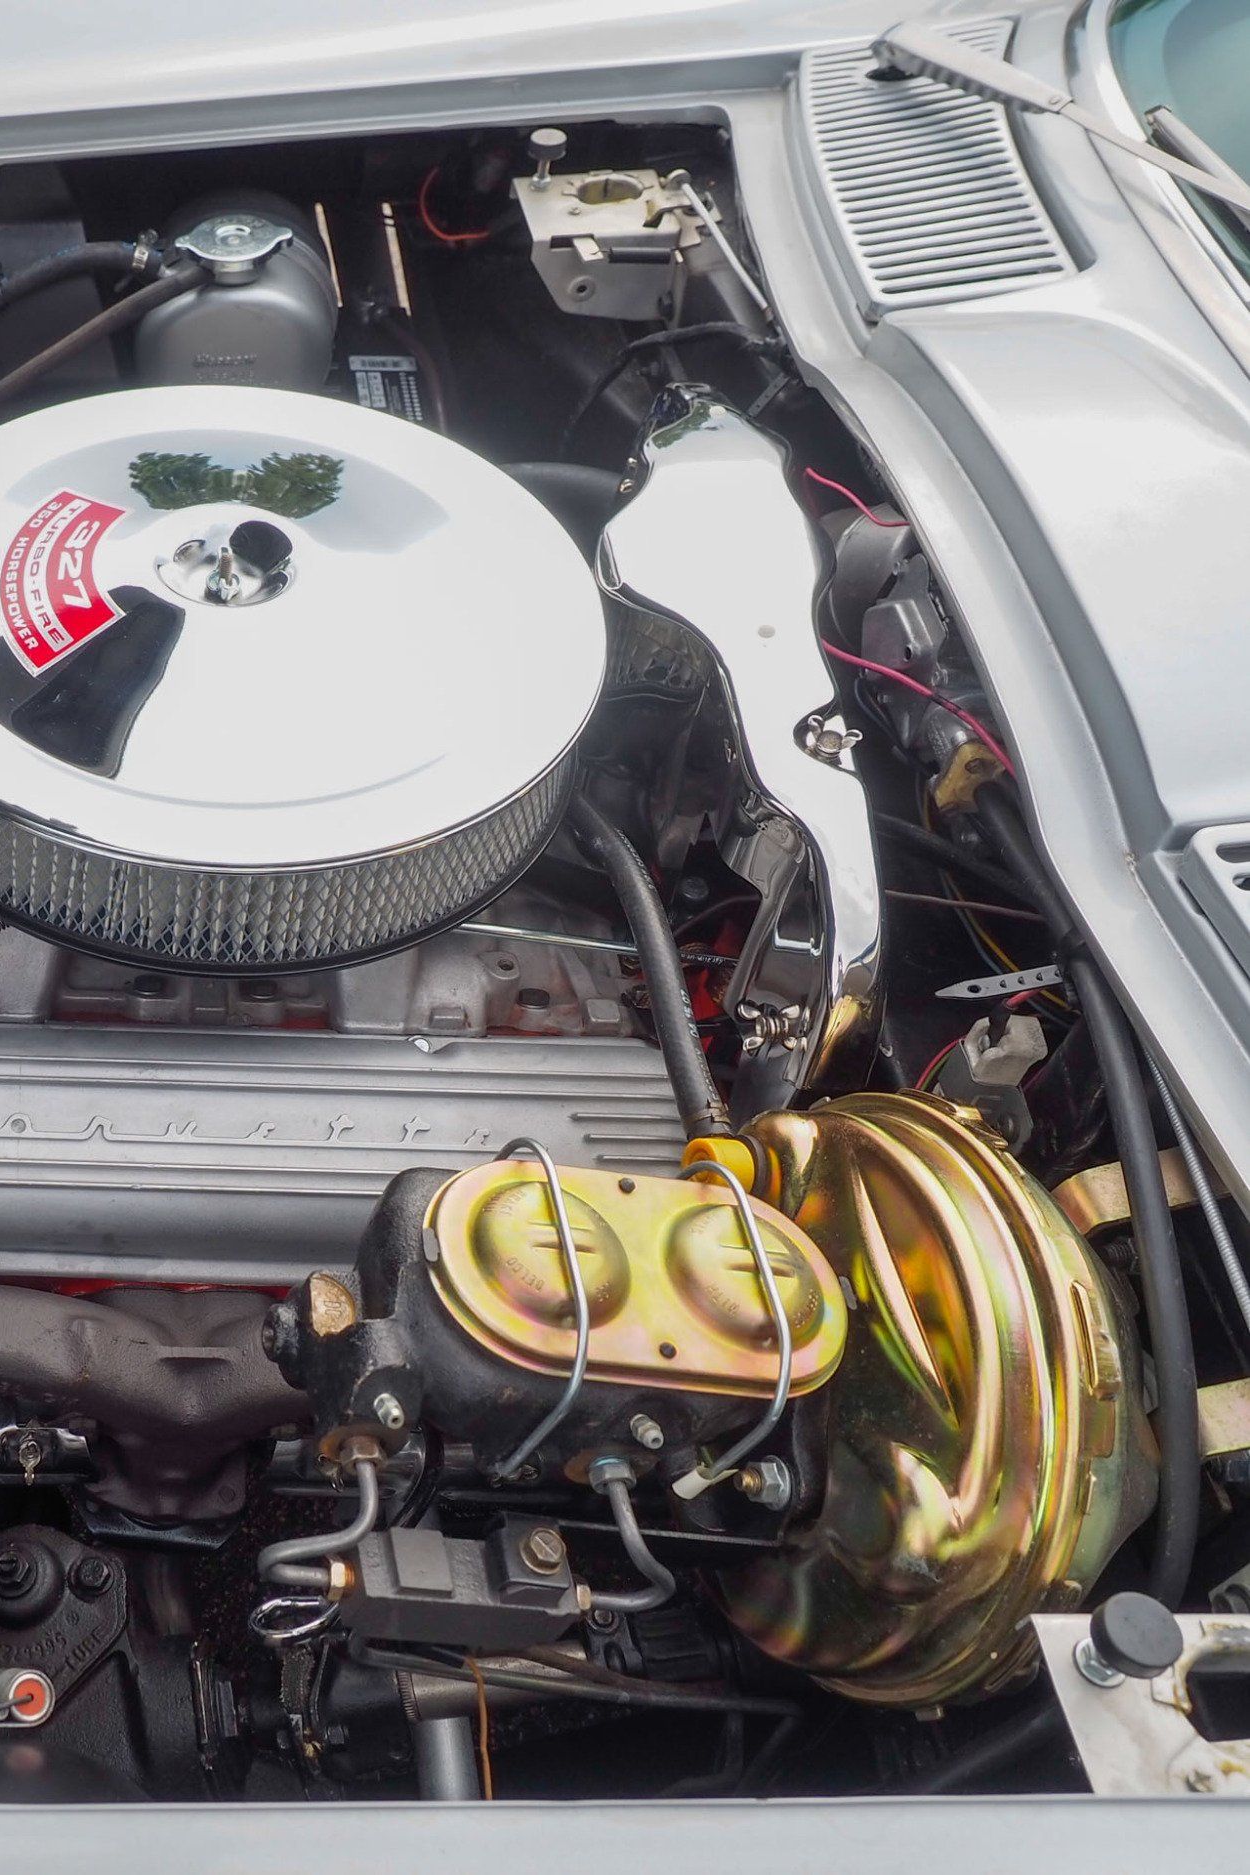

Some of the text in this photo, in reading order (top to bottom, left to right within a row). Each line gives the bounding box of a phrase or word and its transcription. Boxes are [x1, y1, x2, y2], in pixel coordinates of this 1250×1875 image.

[4, 535, 40, 650] HORSEPOWER
[28, 504, 81, 644] TURBO-FIRE
[57, 520, 100, 609] 327
